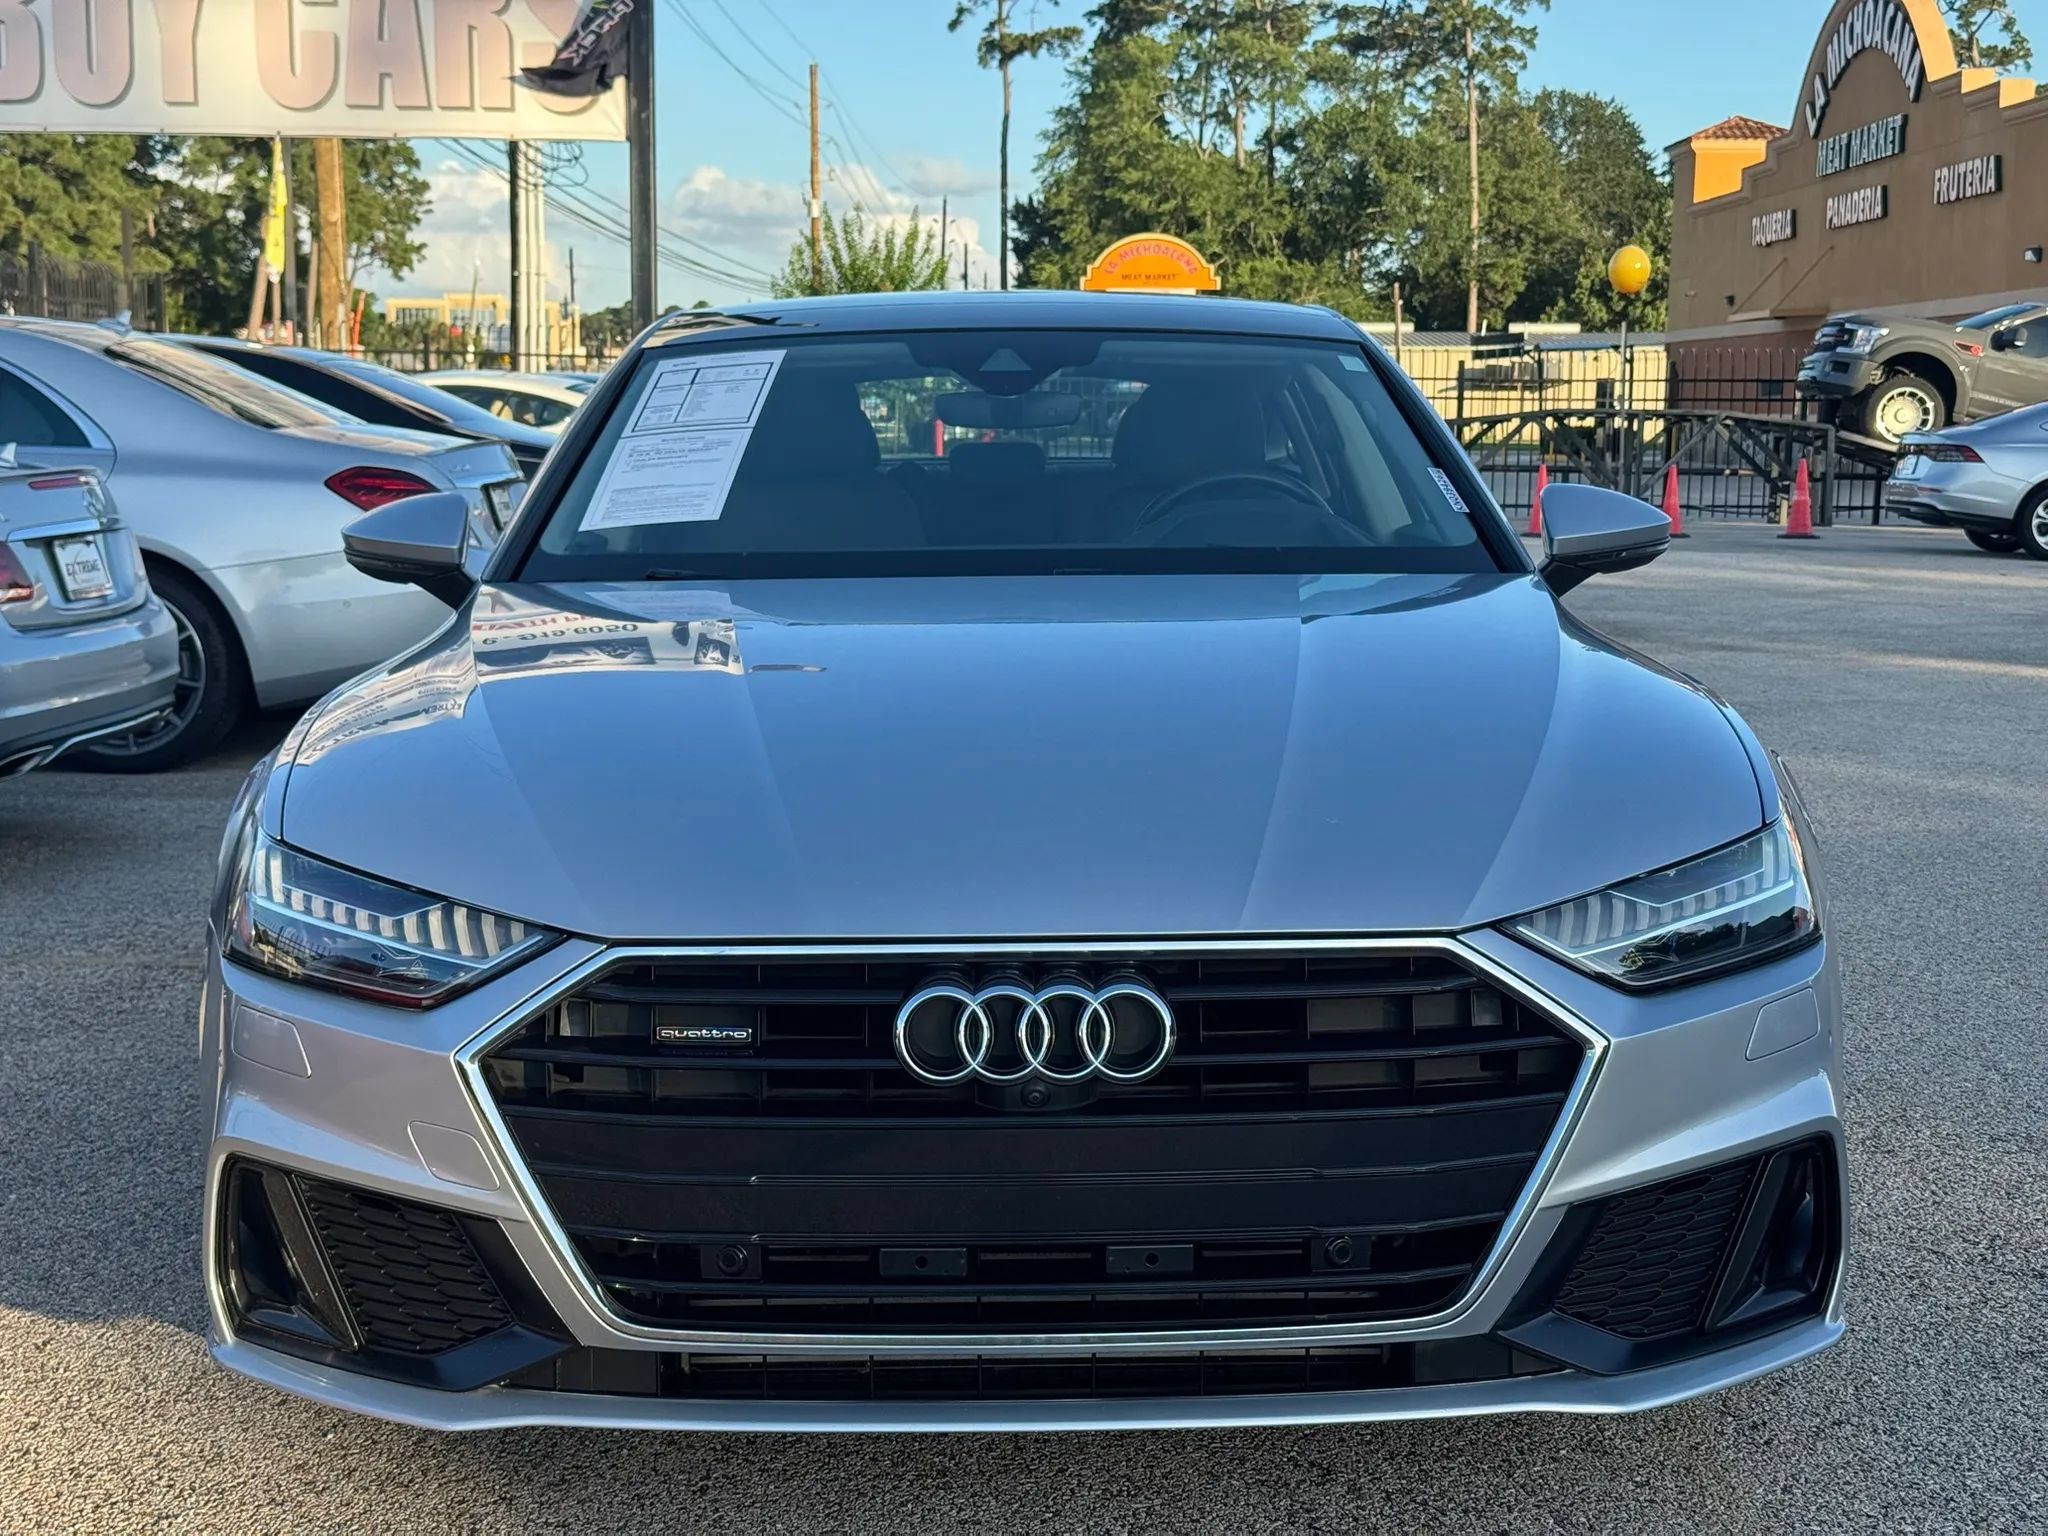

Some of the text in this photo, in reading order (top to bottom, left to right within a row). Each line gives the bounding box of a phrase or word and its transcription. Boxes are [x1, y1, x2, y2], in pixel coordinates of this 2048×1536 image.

[1805, 0, 1921, 138] LA MICHOACANA
[1816, 113, 1903, 177] MEAT MARKET
[1933, 155, 1996, 205] FRUTERIA
[1751, 209, 1792, 247] TAQUERIA
[1826, 185, 1882, 230] PANADERIA
[661, 1029, 747, 1039] quattro
